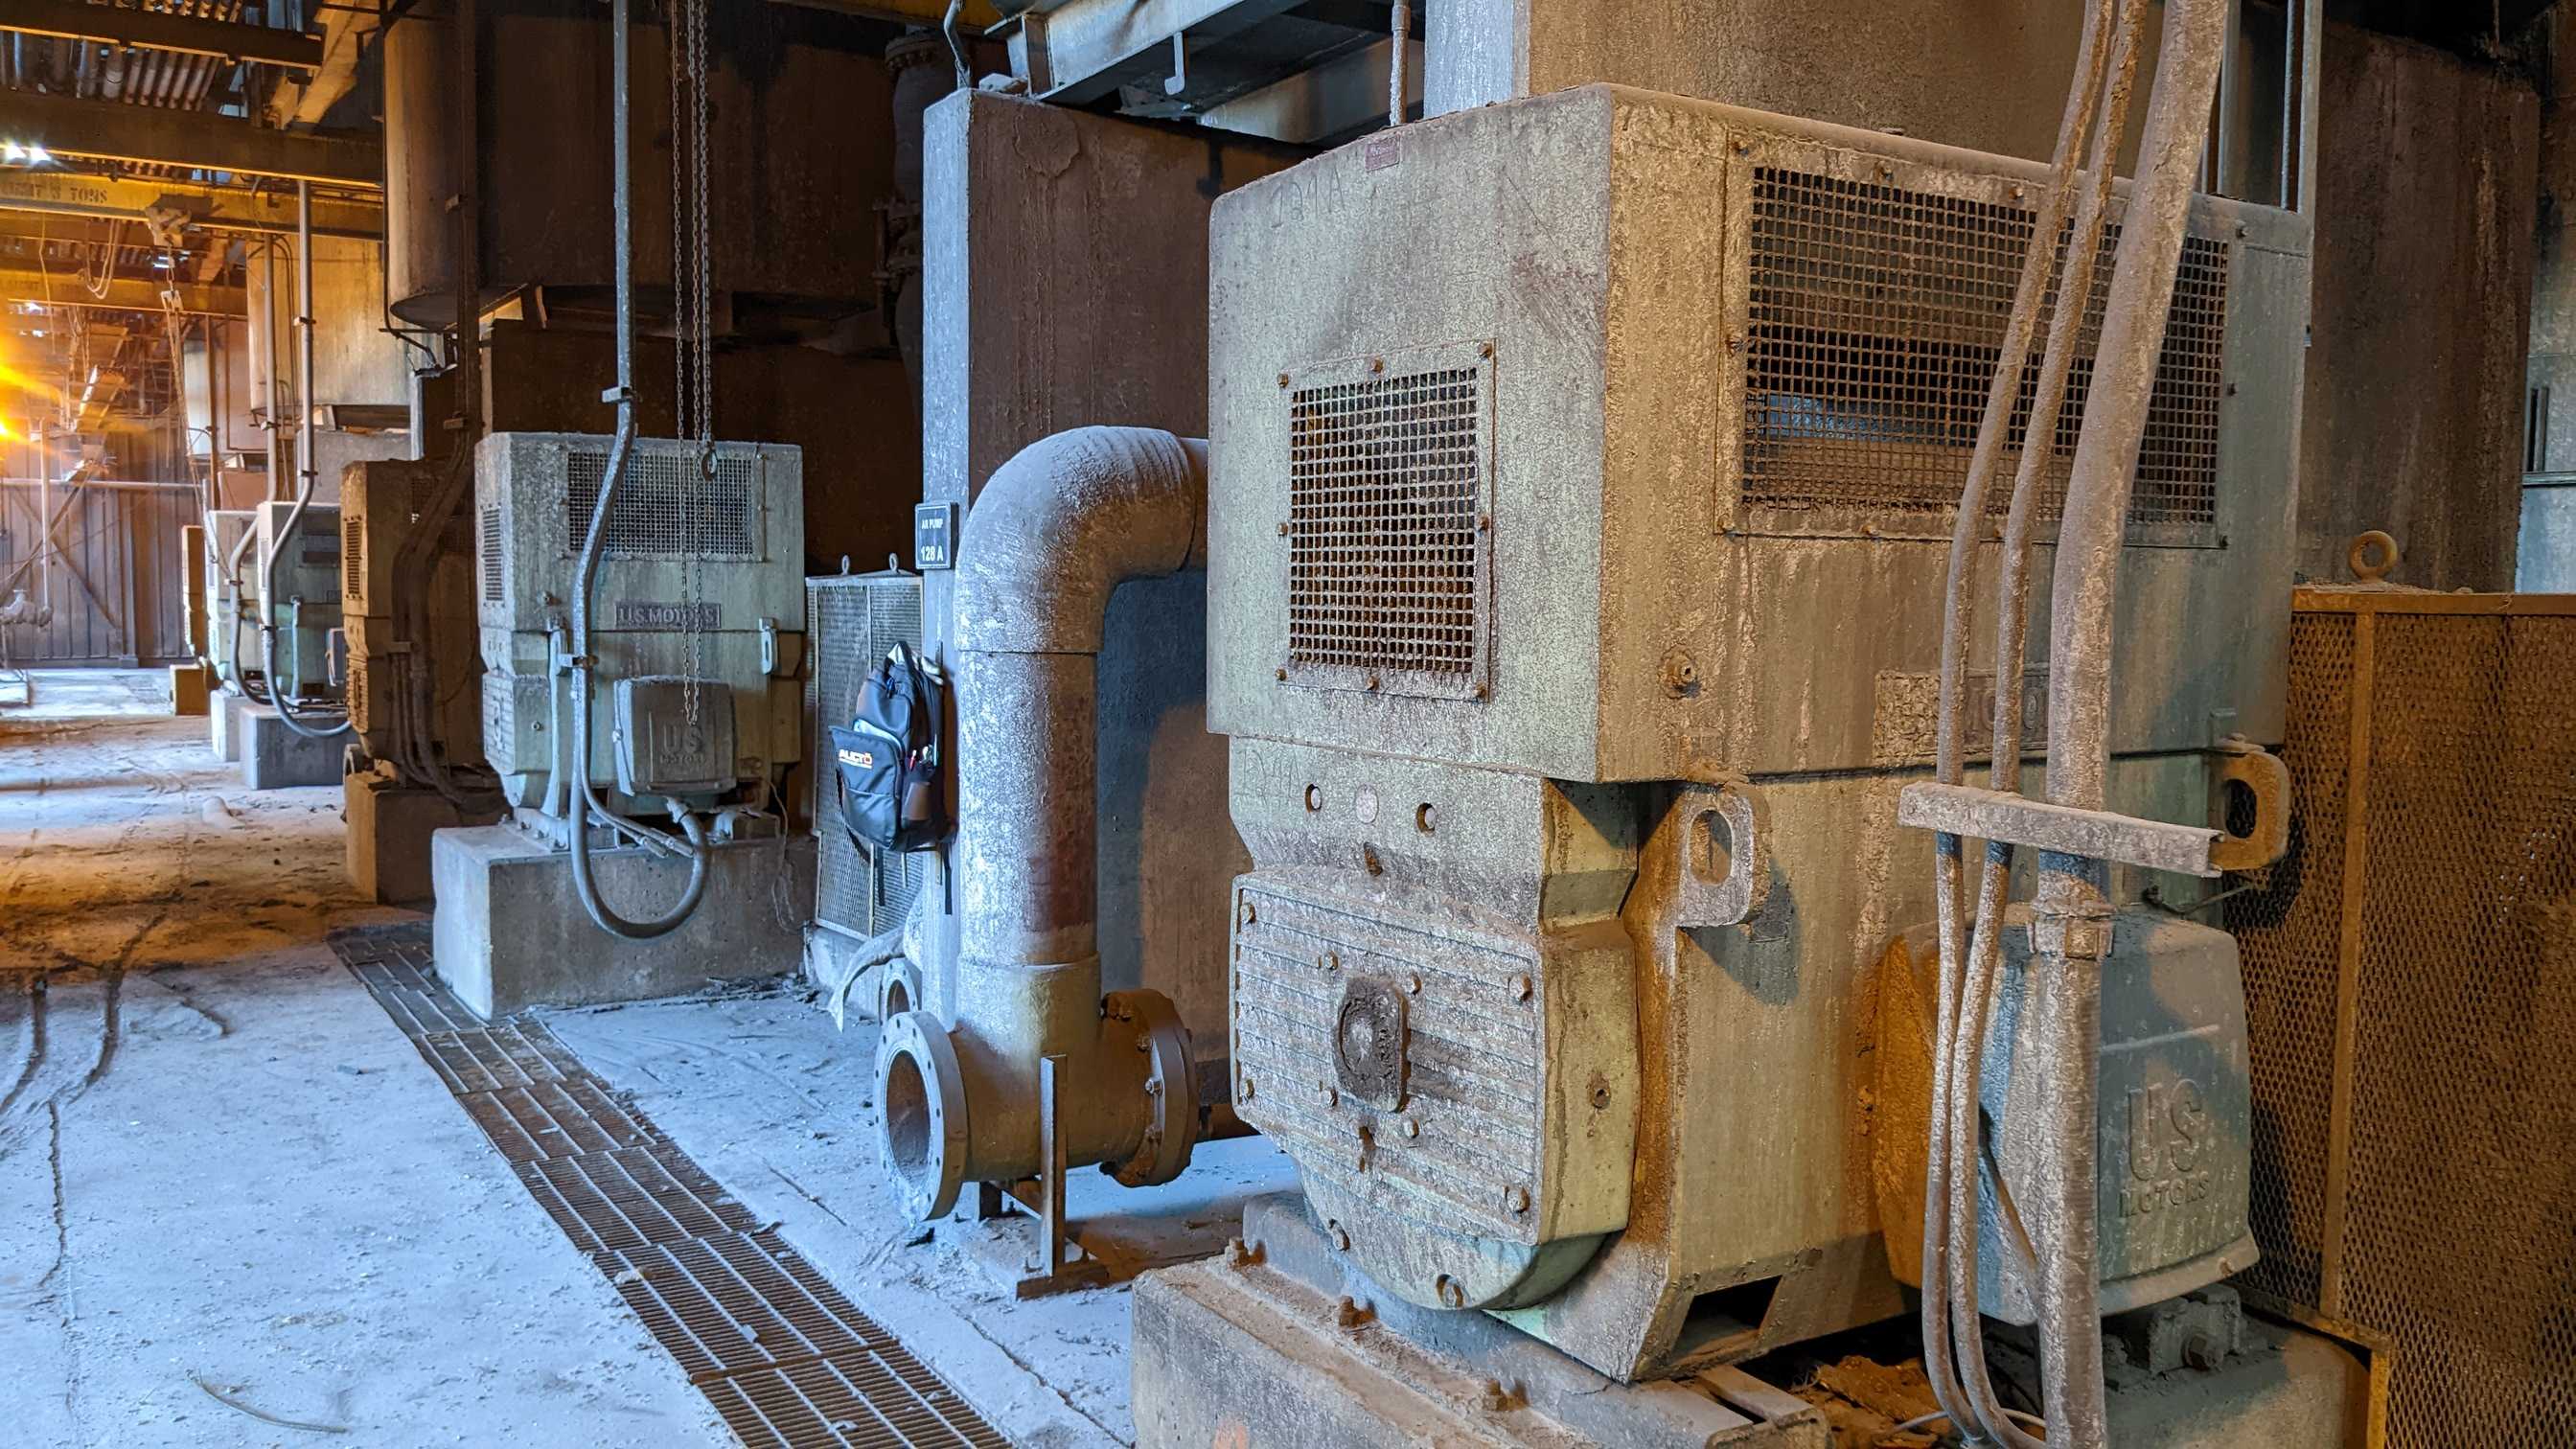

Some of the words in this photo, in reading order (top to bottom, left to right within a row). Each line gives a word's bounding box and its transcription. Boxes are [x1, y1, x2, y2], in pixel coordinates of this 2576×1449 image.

[70, 186, 108, 204] TONS
[930, 518, 944, 530] PUMP
[921, 544, 936, 562] 128
[937, 544, 944, 562] A
[662, 724, 702, 753] US
[2127, 1078, 2203, 1182] US
[2119, 1170, 2210, 1218] MOTORS
